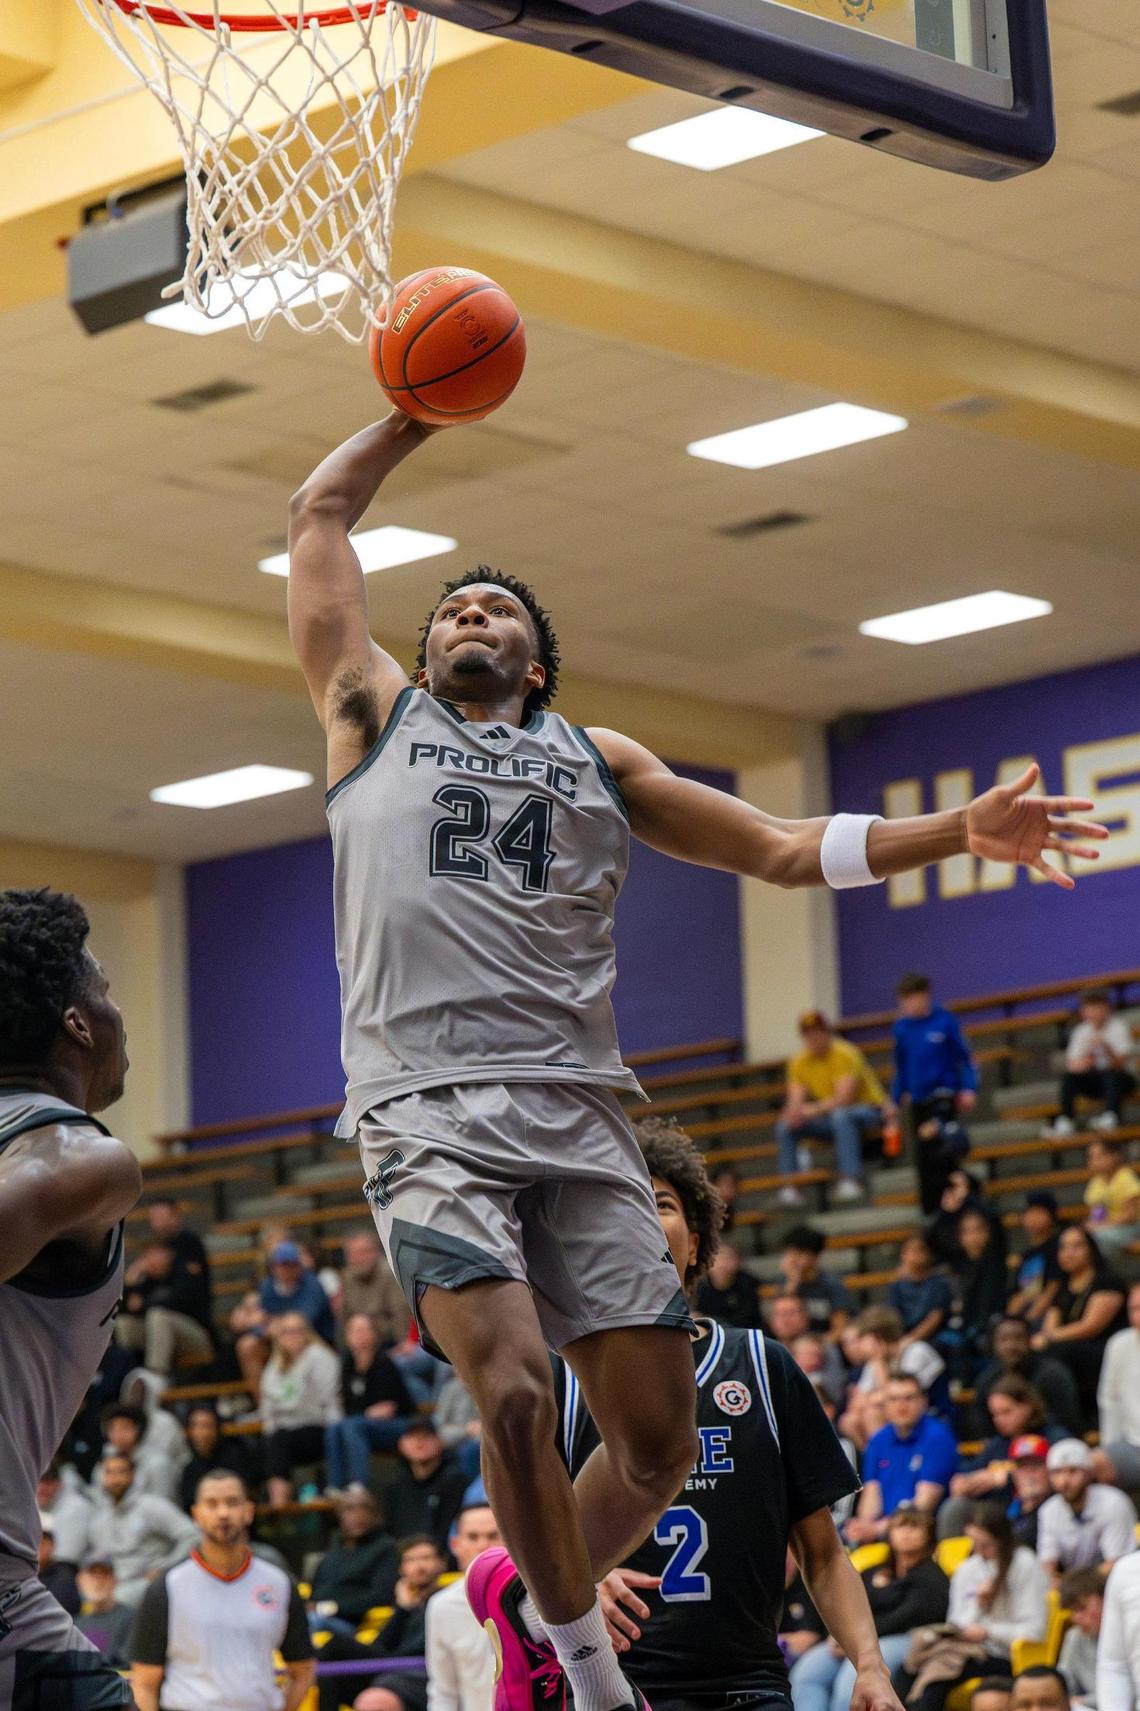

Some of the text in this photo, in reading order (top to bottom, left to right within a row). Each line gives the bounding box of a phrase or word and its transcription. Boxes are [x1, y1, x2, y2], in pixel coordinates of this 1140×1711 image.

[408, 742, 578, 802] PROLIFIC
[429, 783, 557, 893] 24
[690, 1426, 735, 1474] E
[654, 1504, 712, 1603] 2
